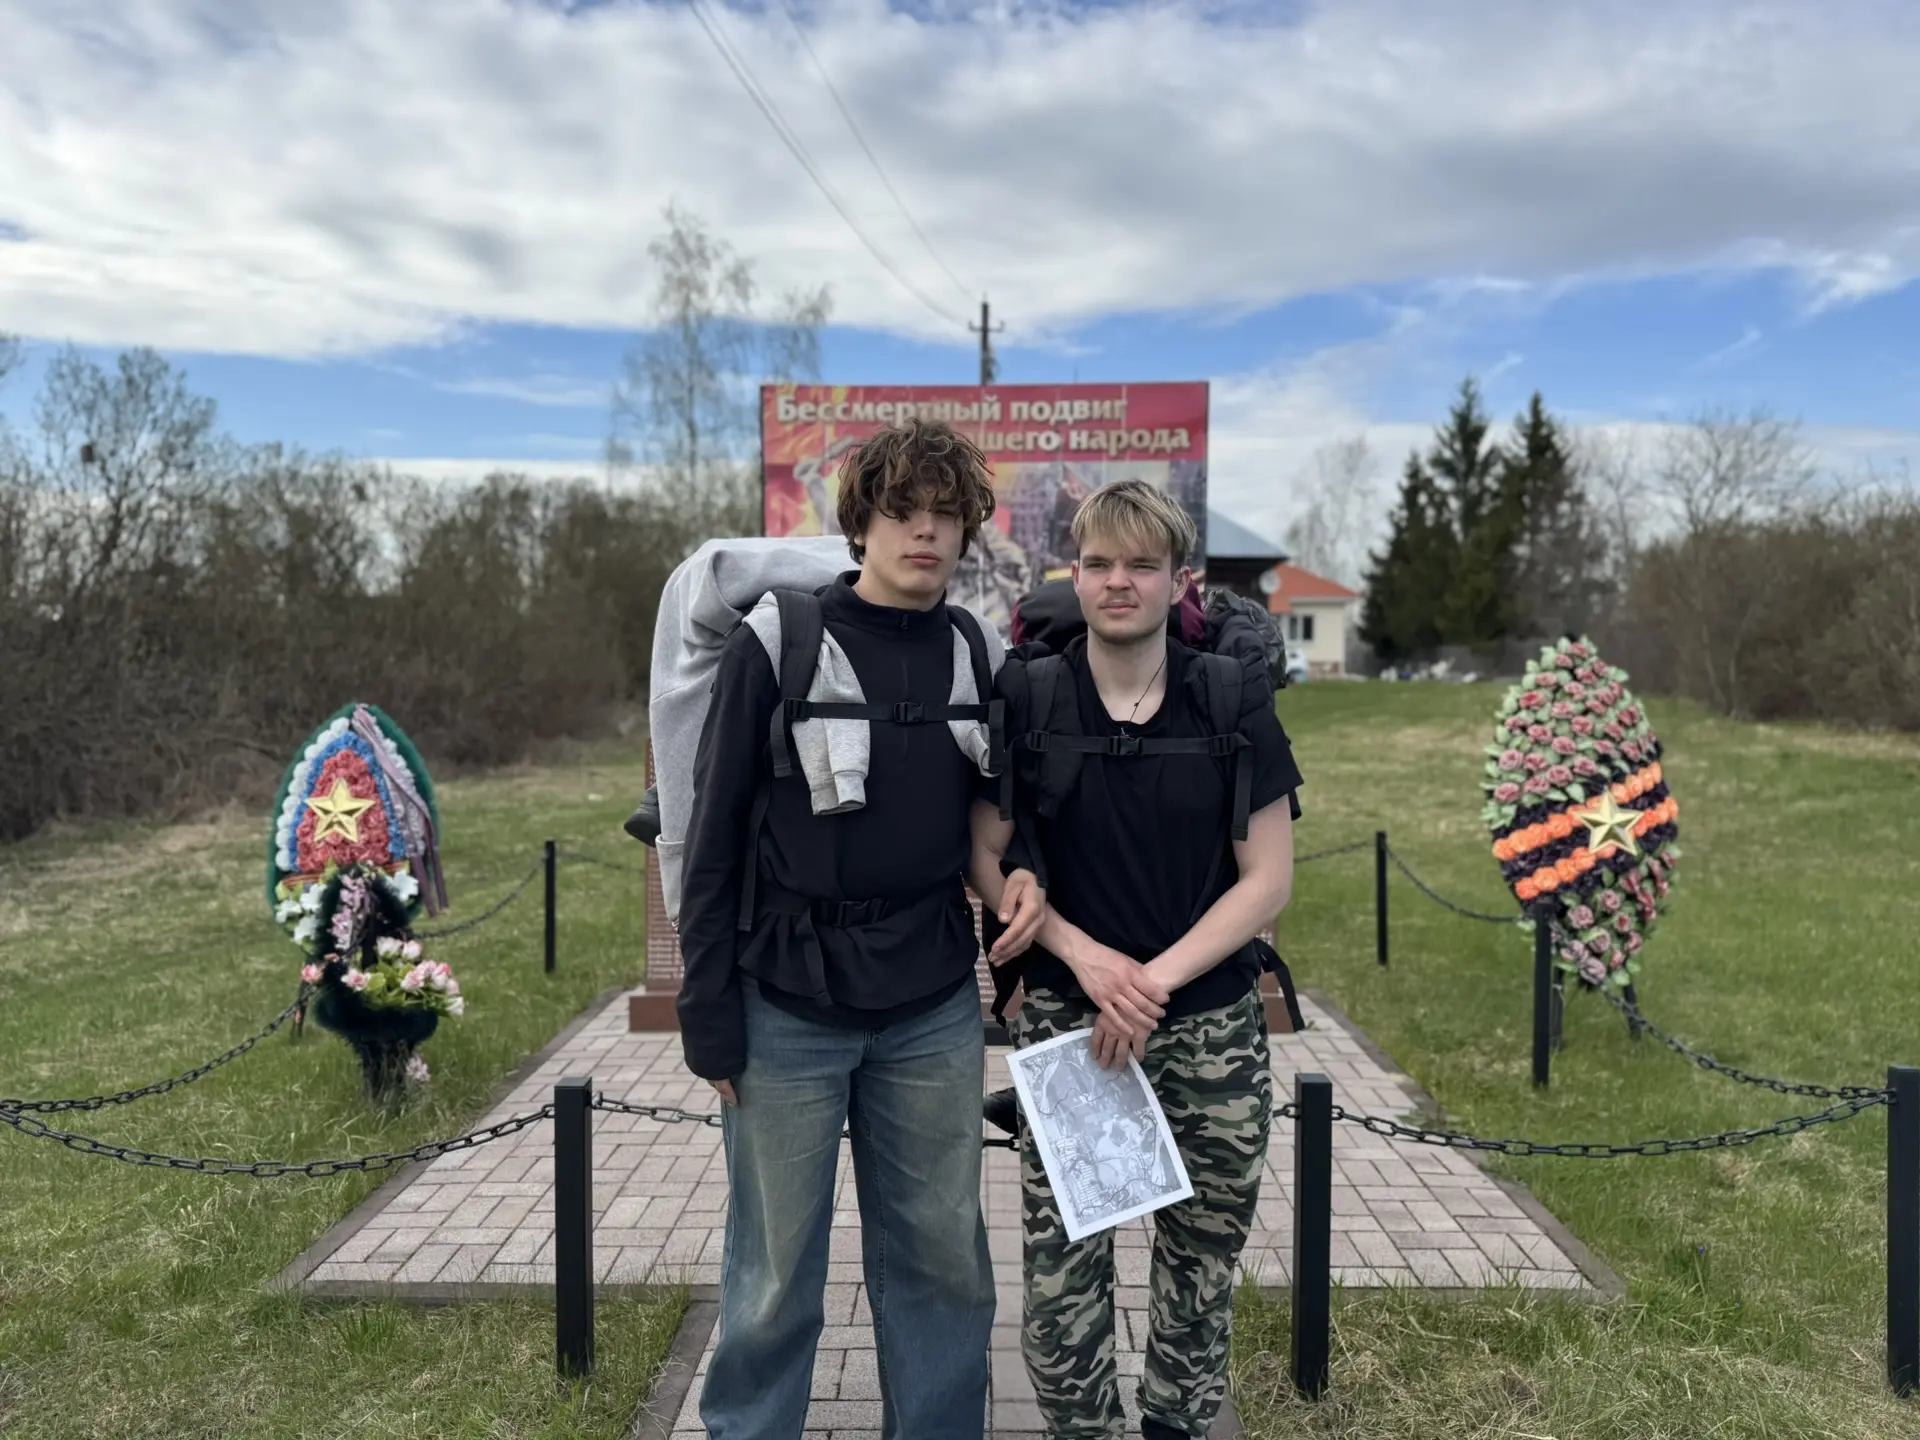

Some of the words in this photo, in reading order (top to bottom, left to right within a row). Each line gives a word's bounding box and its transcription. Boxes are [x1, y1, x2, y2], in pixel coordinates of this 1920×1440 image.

[777, 394, 1001, 428] Бессмертный
[1010, 398, 1127, 426] подвиг
[963, 430, 1062, 452] шего
[1069, 427, 1191, 456] народа
